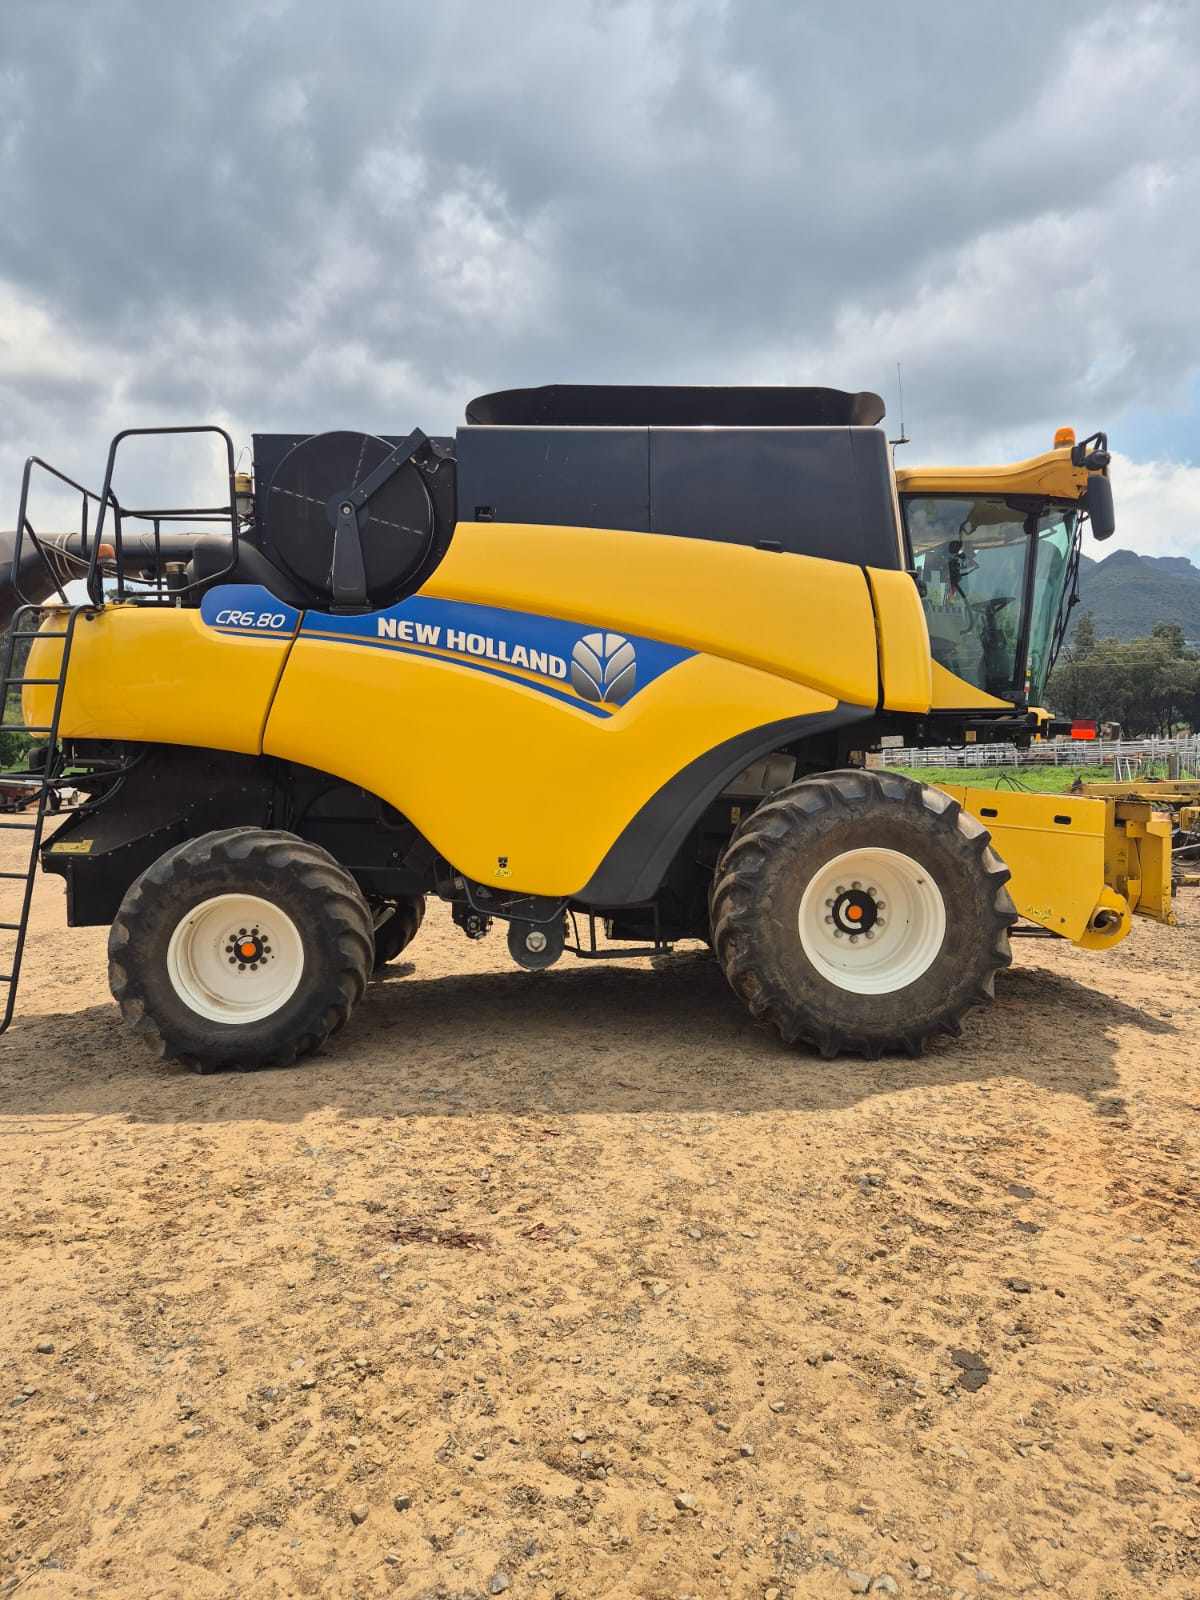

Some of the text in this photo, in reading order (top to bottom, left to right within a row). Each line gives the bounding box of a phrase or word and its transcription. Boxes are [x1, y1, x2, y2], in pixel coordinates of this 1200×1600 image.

[215, 610, 286, 629] CR6.80
[377, 617, 567, 679] NEW HOLLAND
